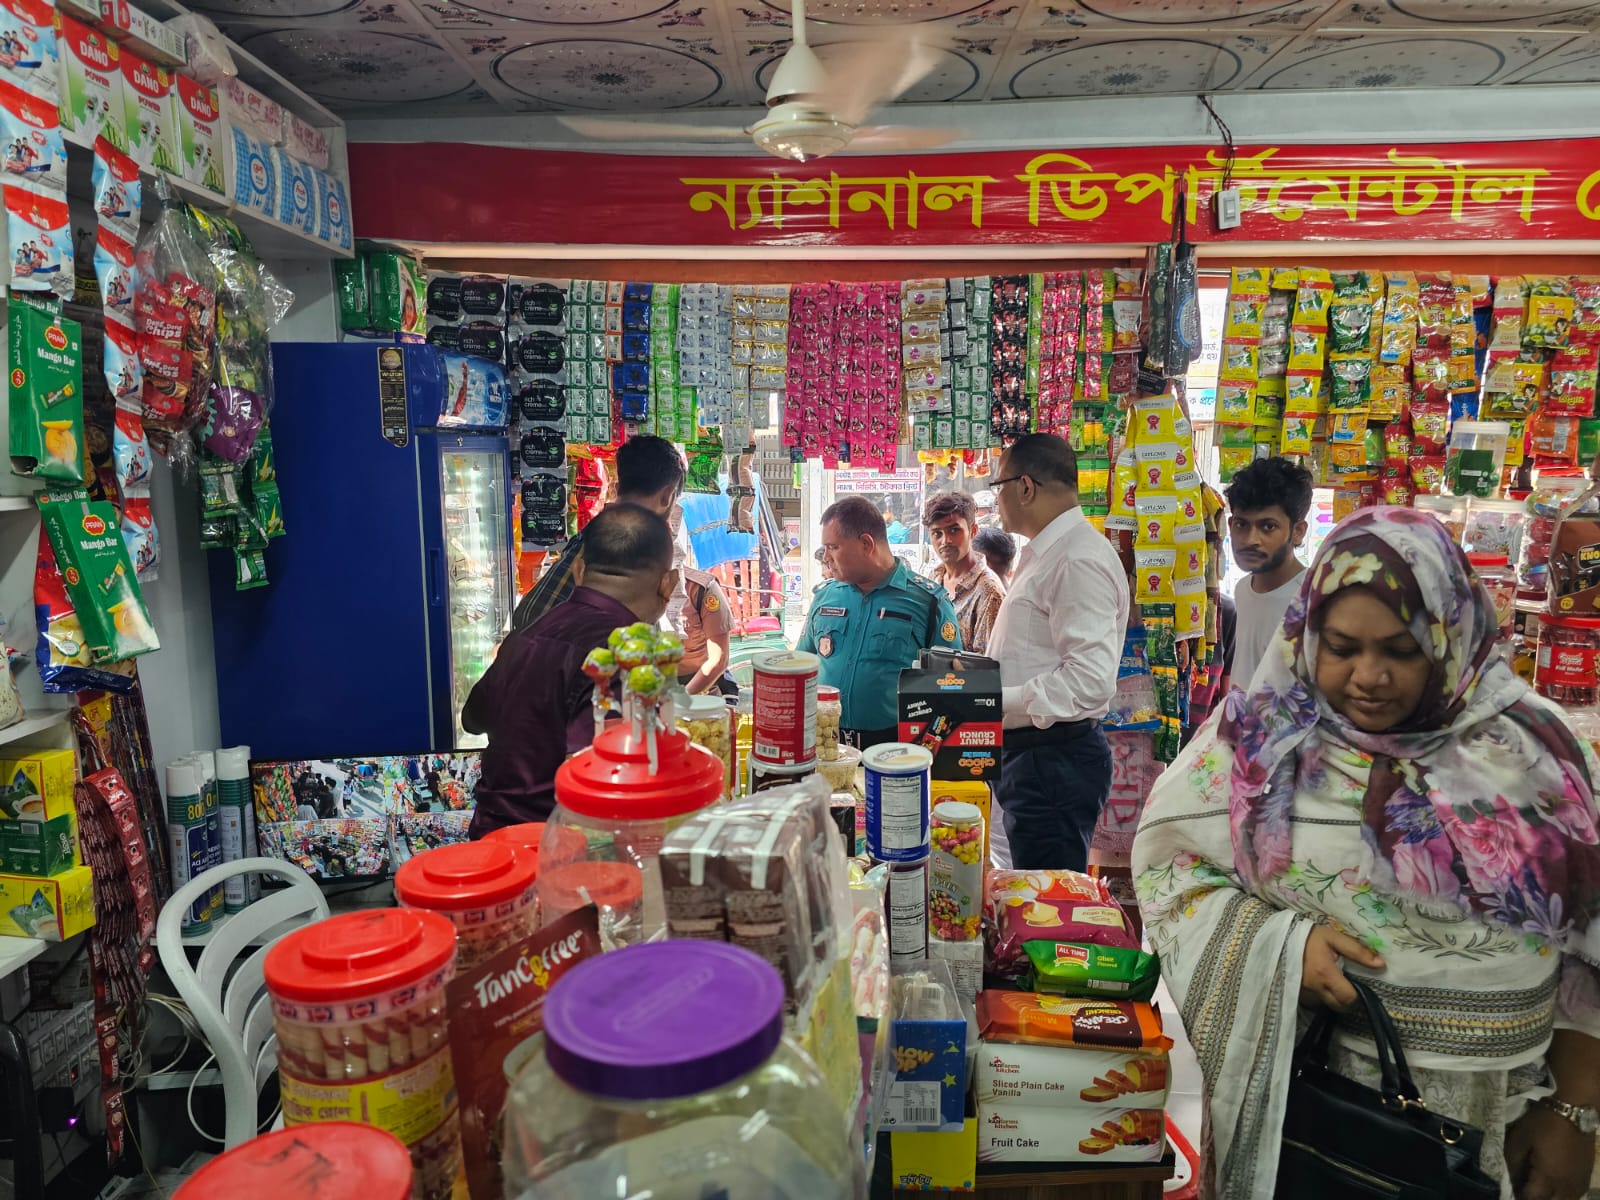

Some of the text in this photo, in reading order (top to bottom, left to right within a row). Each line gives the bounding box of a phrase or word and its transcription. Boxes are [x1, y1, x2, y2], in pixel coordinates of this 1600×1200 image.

[80, 41, 109, 67] DANO
[84, 68, 110, 87] POWER
[133, 69, 159, 94] DANO
[138, 95, 161, 113] POWER
[191, 96, 212, 118] DANO
[193, 120, 213, 136] POWER
[679, 169, 999, 230] ন্যাশনাল
[1014, 147, 1552, 227] ডিপার্টমেন্টাল
[22, 294, 59, 314] Mango Bar
[47, 332, 65, 345] PRAN
[145, 325, 183, 339] Chips
[37, 348, 76, 367] Mango Bar
[49, 490, 88, 503] Mango Bar
[85, 520, 103, 528] PRAN
[80, 538, 117, 550] Mango Bar
[907, 700, 928, 710] YUMMY
[985, 698, 996, 708] 10
[908, 707, 933, 718] CRUNCHY
[958, 757, 996, 769] CHOCO
[1071, 949, 1086, 957] TIME
[1073, 1015, 1129, 1025] CREAMY
[993, 1080, 1065, 1090] Sliced Plain Cake
[993, 1089, 1022, 1097] Vanilla
[992, 1138, 1040, 1148] Fruit Cake
